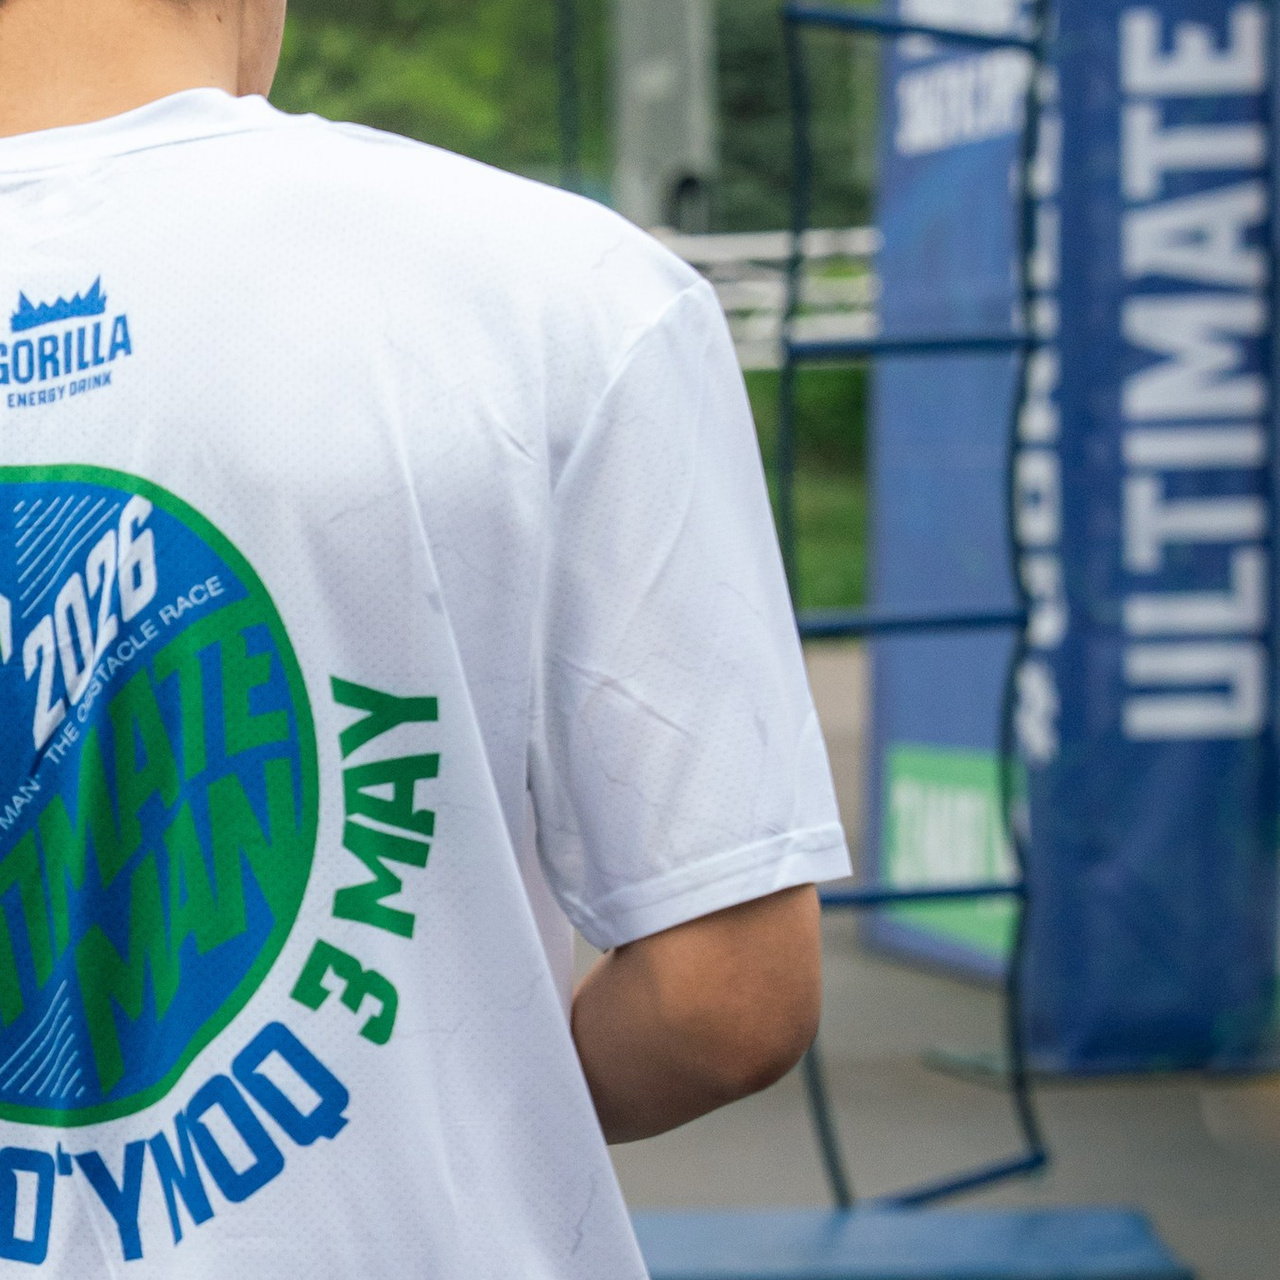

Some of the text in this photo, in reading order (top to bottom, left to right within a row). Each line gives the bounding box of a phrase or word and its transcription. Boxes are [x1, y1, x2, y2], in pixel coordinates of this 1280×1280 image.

[7, 371, 113, 409] ENERGY DRINK
[1118, 1, 1269, 740] ULTIMATE
[23, 494, 158, 751] 2026
[43, 721, 81, 764] THE
[159, 575, 226, 625] RACE
[73, 756, 295, 1097] MAN
[330, 674, 441, 940] MAY
[289, 938, 399, 1046] 3
